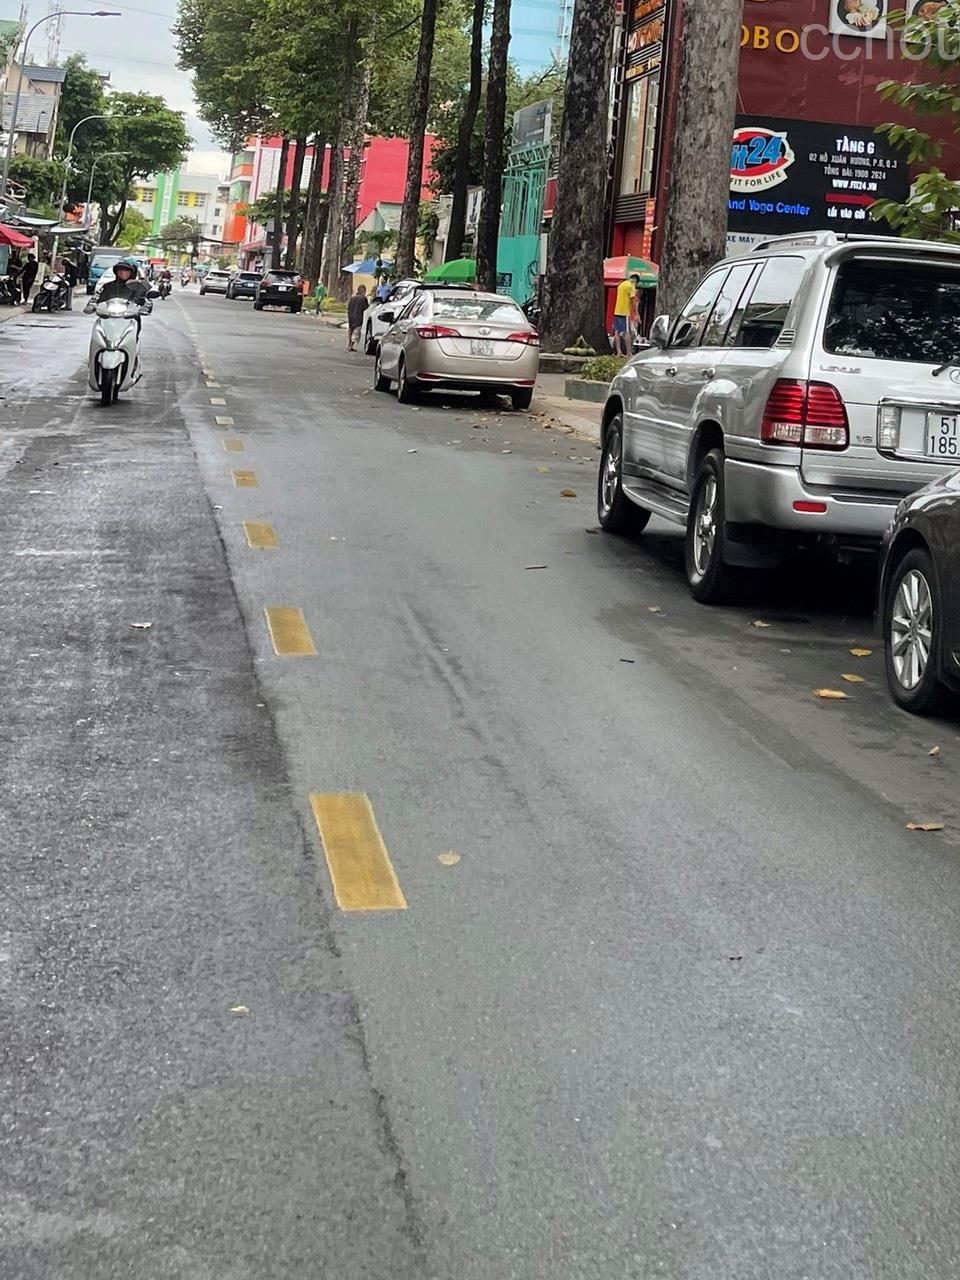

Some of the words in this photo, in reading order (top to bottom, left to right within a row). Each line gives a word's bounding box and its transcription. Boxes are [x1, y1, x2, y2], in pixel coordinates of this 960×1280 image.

[731, 135, 783, 171] it24
[836, 136, 865, 154] TẦNG
[745, 179, 763, 187] FOR
[764, 170, 782, 184] LIFE
[749, 199, 774, 215] Yoga
[776, 201, 812, 216] Center
